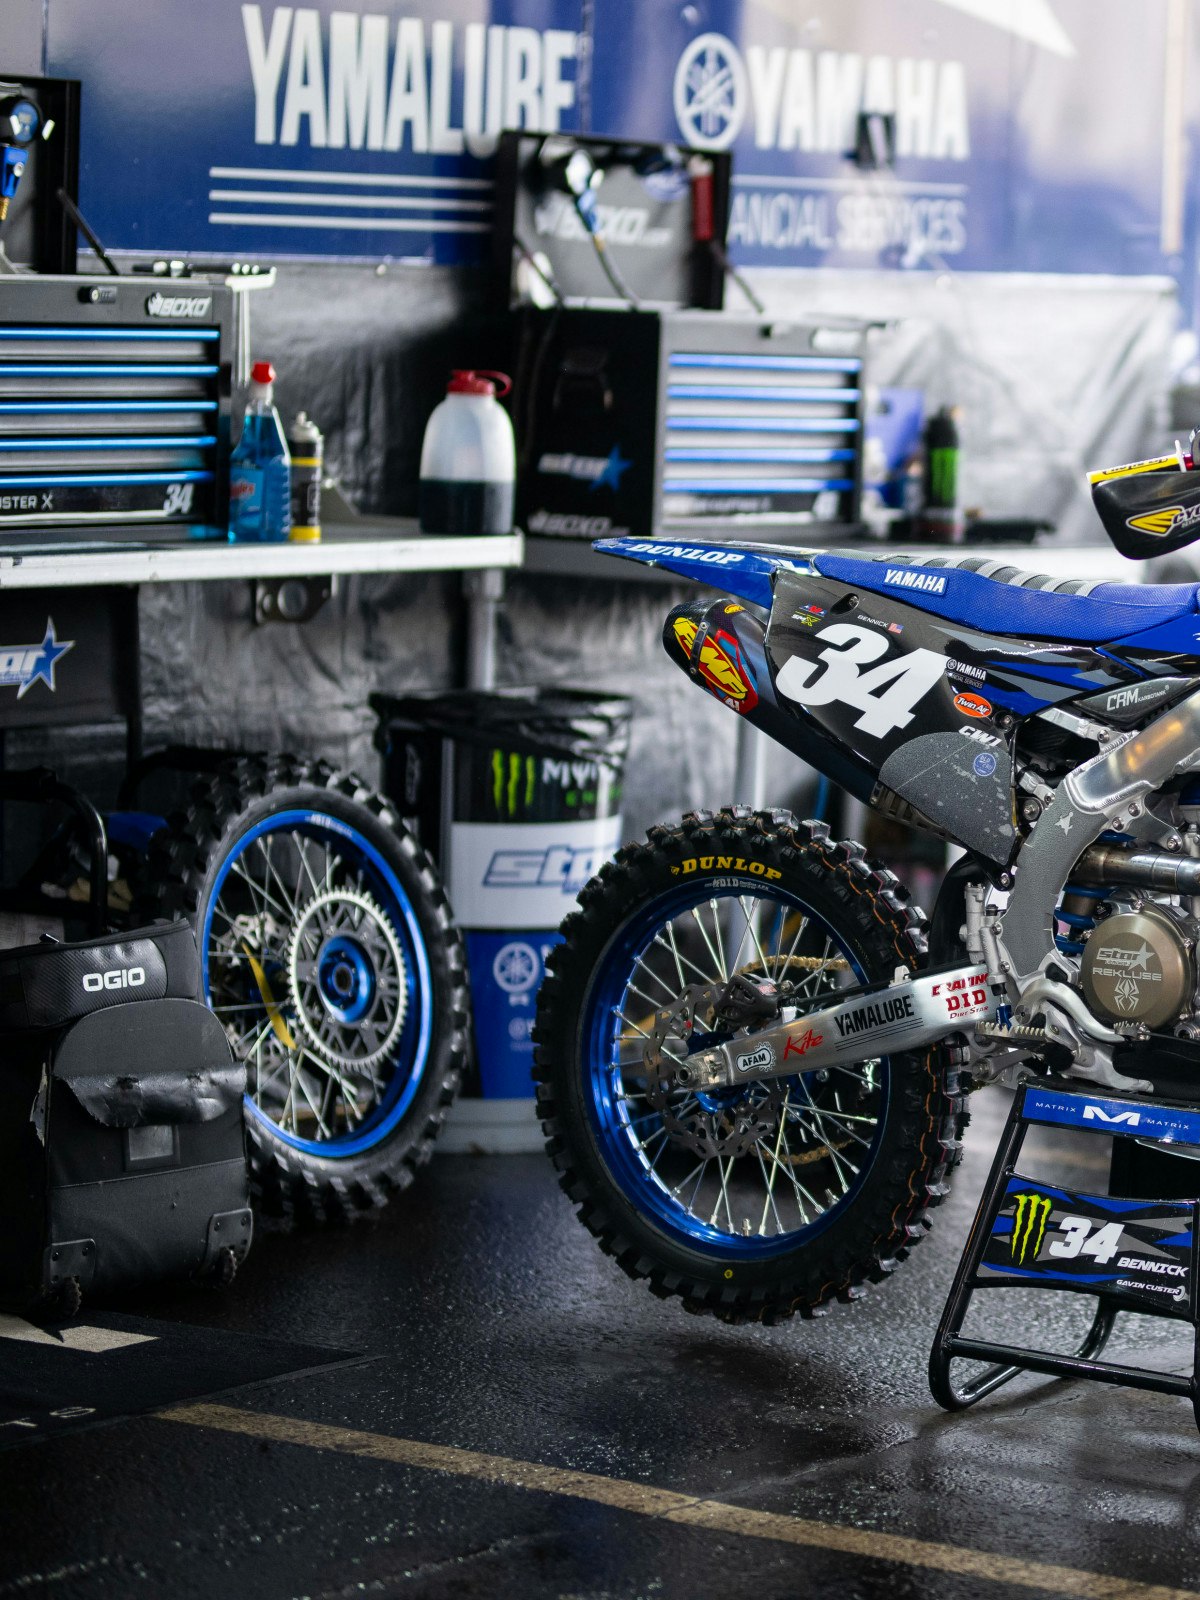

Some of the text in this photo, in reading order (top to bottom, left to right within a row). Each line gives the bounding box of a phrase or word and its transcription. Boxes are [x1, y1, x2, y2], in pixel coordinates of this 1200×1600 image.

[241, 4, 577, 157] YAMALUBE
[746, 45, 969, 161] YAMAHA
[0, 494, 54, 510] STER X
[163, 484, 194, 514] 34
[626, 543, 746, 566] DUNLOP
[885, 569, 947, 593] YAMAHA
[857, 614, 889, 628] BENNICK
[775, 623, 951, 739] 34
[955, 662, 988, 681] YAMAHA
[957, 696, 990, 715] Twin Air
[1106, 687, 1140, 713] CRM
[682, 856, 782, 880] DUNLOP
[83, 966, 146, 992] OGIO
[1092, 967, 1162, 982] REKLUSE
[834, 995, 915, 1037] YAMALUBE
[783, 1029, 824, 1060] Kite
[742, 1053, 767, 1067] AFAM
[1035, 1101, 1077, 1113] MATRIX
[1146, 1118, 1190, 1130] MATRIX
[1048, 1216, 1126, 1264] 34
[1117, 1256, 1190, 1278] BENNICK
[1116, 1279, 1180, 1295] GAVIN CUSTER
